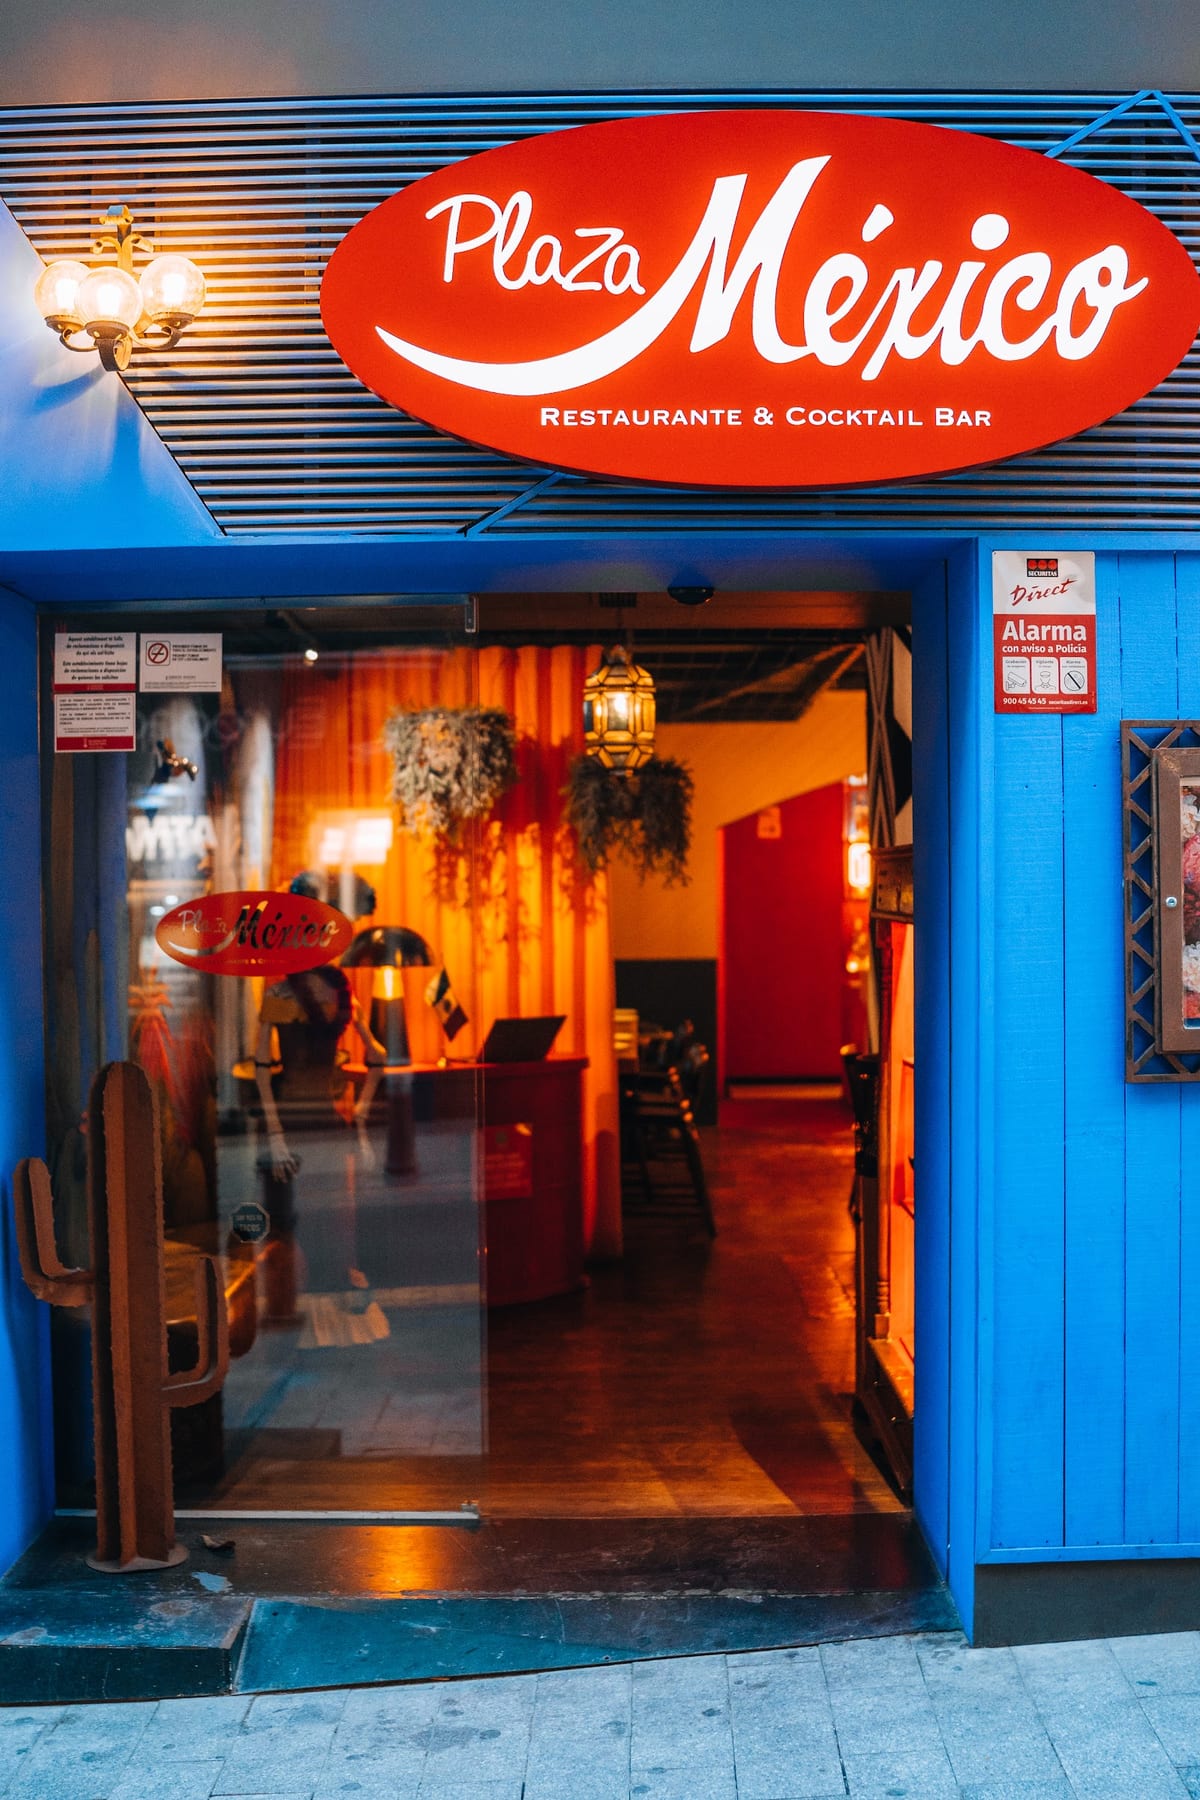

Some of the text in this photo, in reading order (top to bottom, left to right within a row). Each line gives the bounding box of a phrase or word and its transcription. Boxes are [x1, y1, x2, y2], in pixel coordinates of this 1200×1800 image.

[375, 154, 1149, 396] Plaza México
[540, 406, 991, 428] RESTAURANTE & COCKTAIL BAR
[1010, 578, 1079, 606] Direct
[1002, 618, 1087, 641] Alarma
[1002, 643, 1087, 653] con aviso a Policía
[1003, 697, 1017, 705] 900
[1018, 697, 1027, 705] 45
[1027, 697, 1036, 705] 45
[1037, 697, 1046, 705] 45
